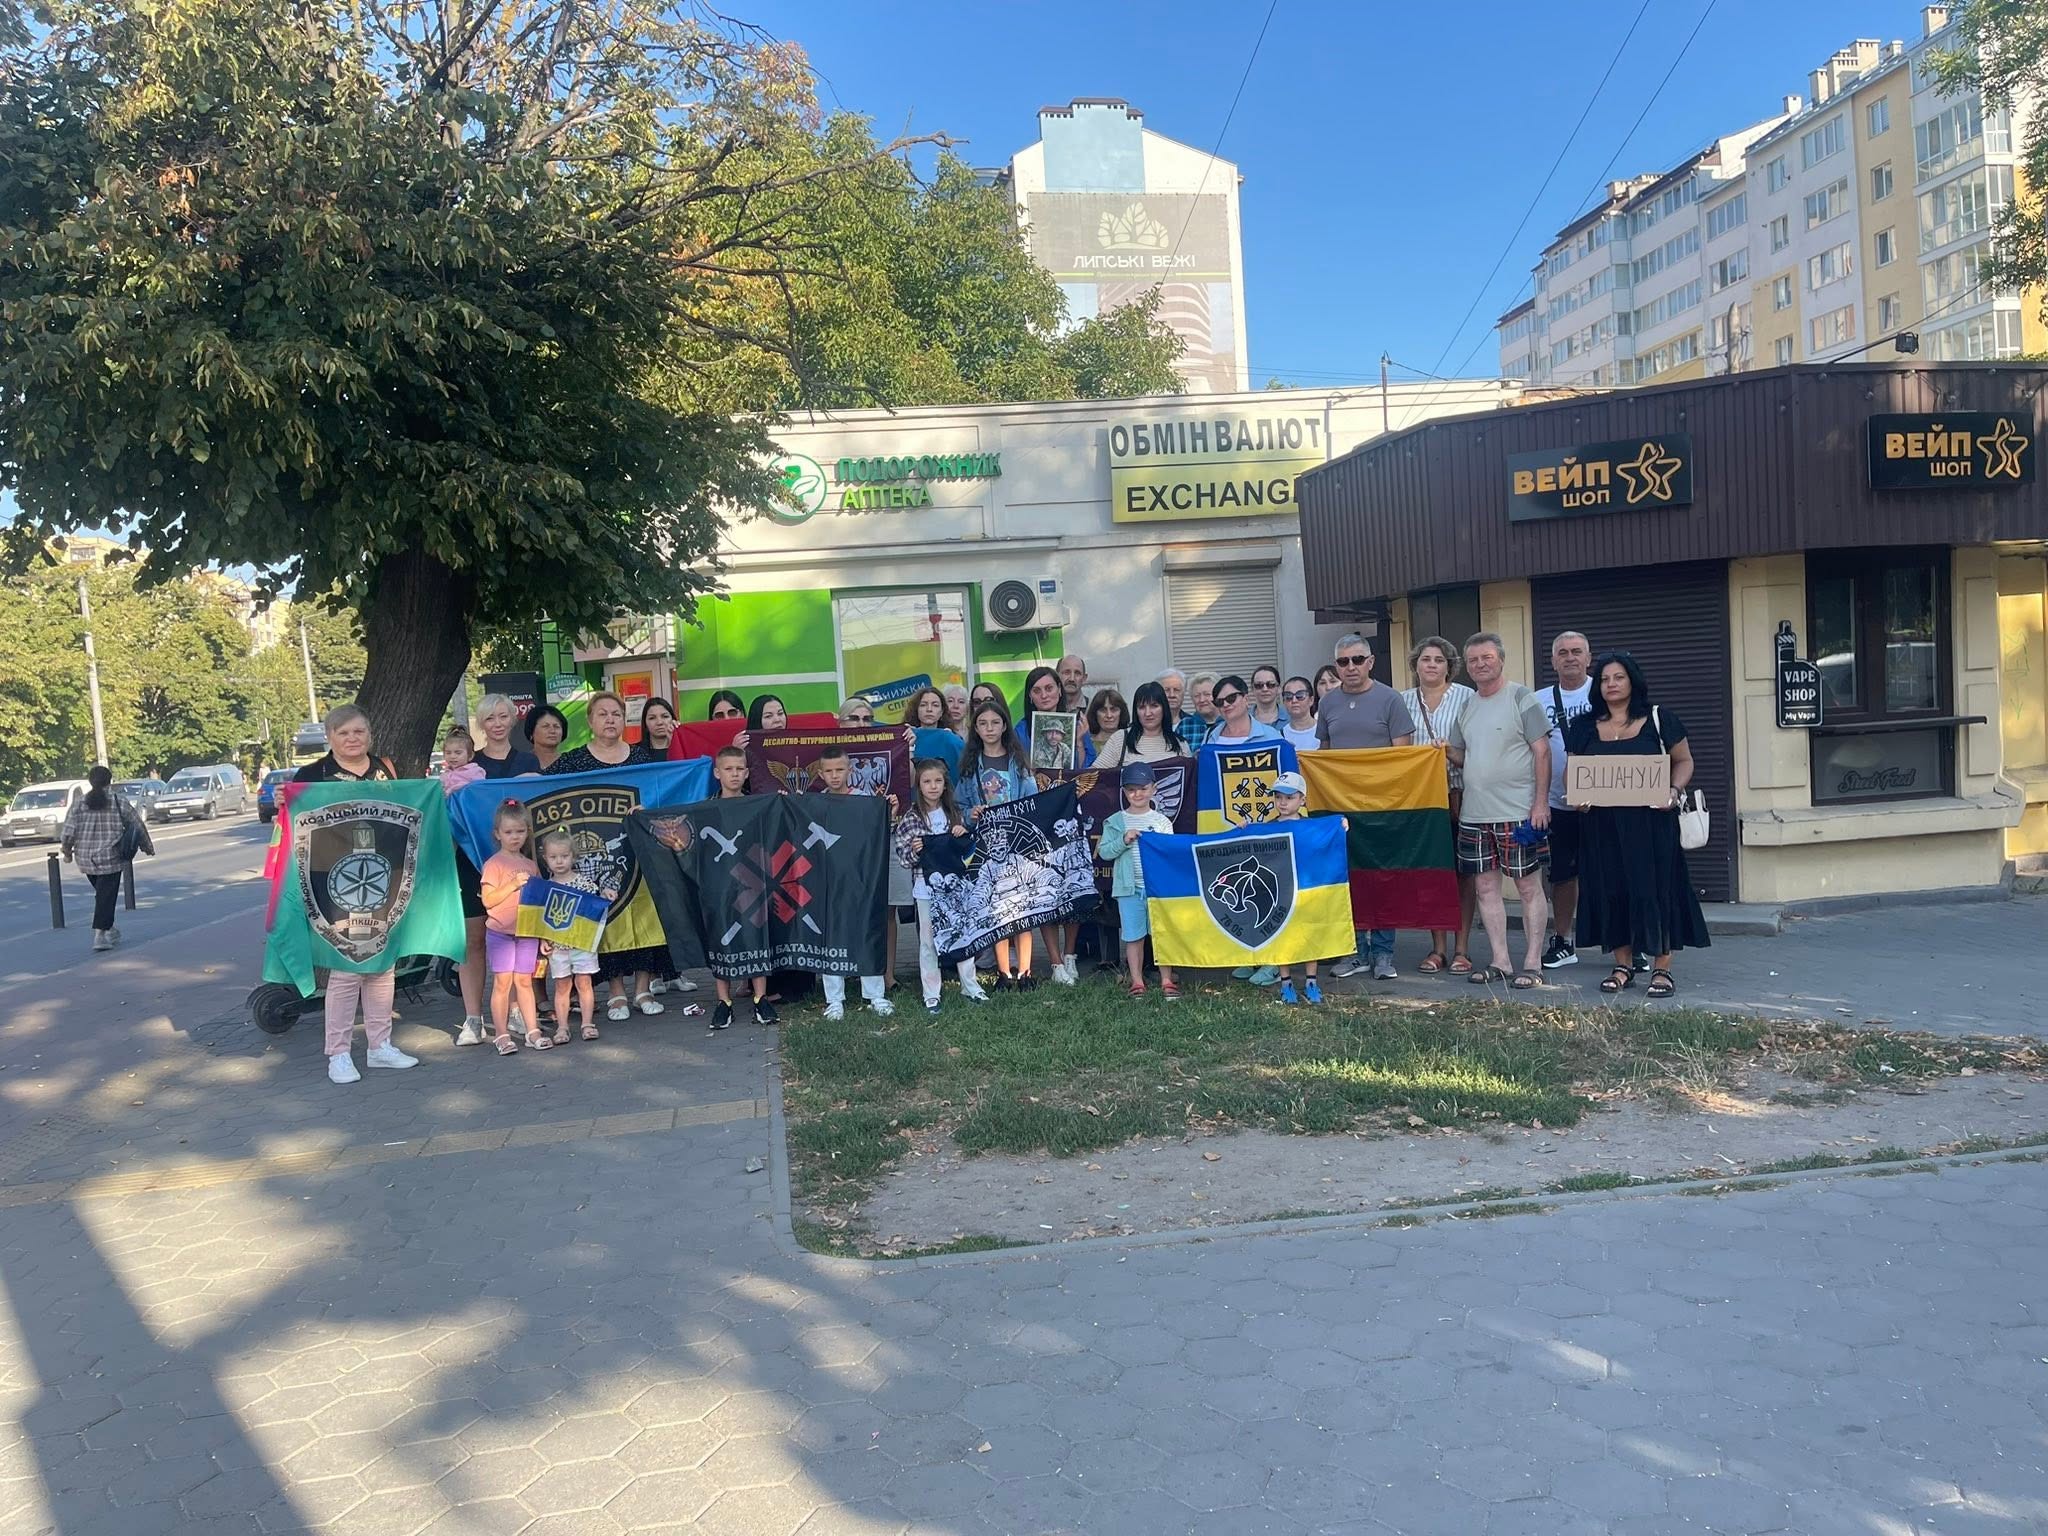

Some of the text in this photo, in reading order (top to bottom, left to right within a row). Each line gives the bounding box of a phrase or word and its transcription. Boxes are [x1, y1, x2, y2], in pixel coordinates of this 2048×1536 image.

[1073, 254, 1196, 269] ЛИПСЬКІ ВЕЖІ
[1110, 417, 1321, 458] ОБМІН ВАЛЮТ
[1886, 423, 1972, 459] ВЕЙП
[837, 453, 1001, 482] ПОДОРОЖНИК
[1513, 456, 1610, 495] ВЕЙП
[1930, 461, 1972, 477] ШОП
[842, 485, 934, 509] АПТЕКА
[1562, 490, 1610, 508] ШОП
[1784, 670, 1816, 683] VAPE
[1784, 688, 1817, 702] SHOP
[1784, 711, 1816, 721] My Vape
[1226, 752, 1272, 769] РІЙ
[1576, 761, 1663, 790] ВШАНУЙ
[299, 807, 379, 827] КОЗАЦЬКИЙ
[536, 797, 630, 825] 462 ОПБ
[797, 956, 858, 972] ОБОРОНИ
